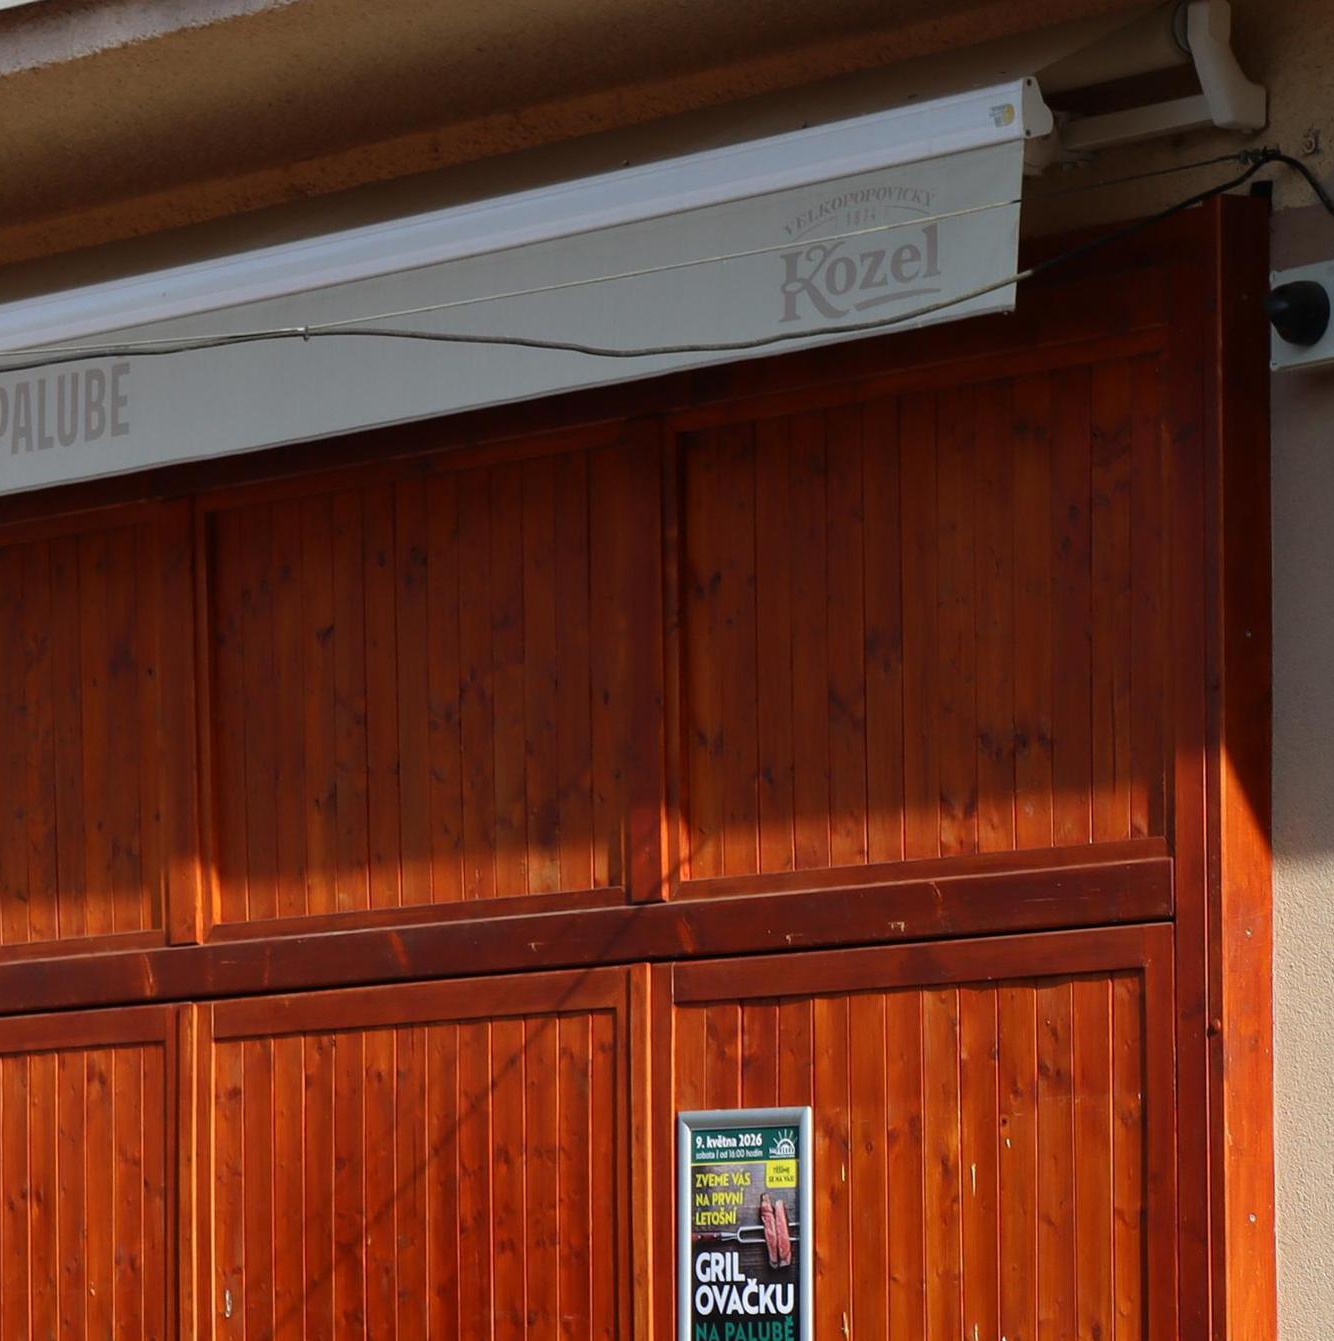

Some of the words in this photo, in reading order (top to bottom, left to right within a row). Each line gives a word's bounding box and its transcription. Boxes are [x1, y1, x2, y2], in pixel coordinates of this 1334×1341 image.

[779, 223, 941, 323] Kozel
[695, 1136, 705, 1149] 9.
[707, 1134, 737, 1149] května
[738, 1133, 763, 1147] 2026
[720, 1149, 728, 1158] od
[695, 1172, 729, 1188] ZVEME
[730, 1168, 751, 1186] VÁS
[695, 1193, 710, 1206] NA
[712, 1188, 744, 1205] PRVNÍ
[695, 1206, 738, 1226] LETOŠNÍ
[695, 1251, 746, 1282] GRIL
[695, 1278, 795, 1316] OVAČKU
